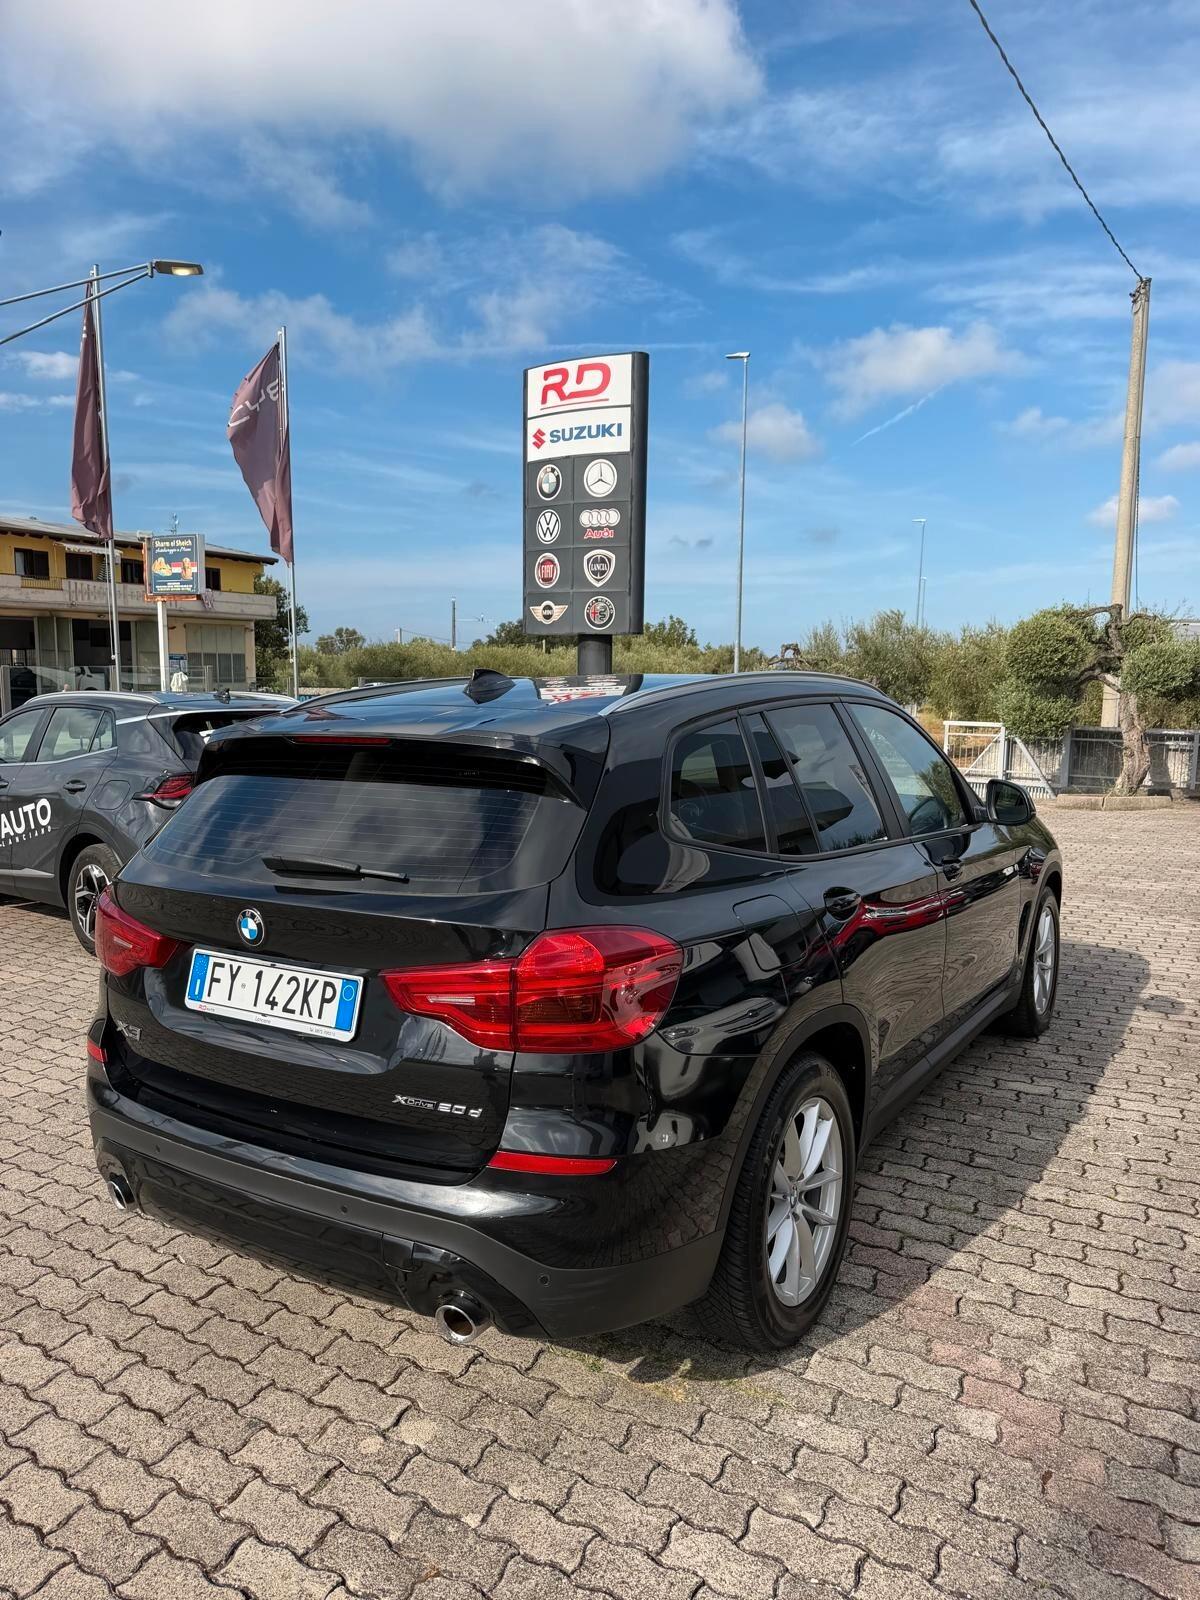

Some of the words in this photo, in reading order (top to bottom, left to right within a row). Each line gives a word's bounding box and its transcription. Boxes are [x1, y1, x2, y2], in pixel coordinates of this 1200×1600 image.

[541, 362, 611, 405] RD
[549, 422, 622, 444] SUZUKI
[584, 528, 614, 539] Audi
[541, 564, 554, 579] FIAT
[542, 608, 554, 616] MINI
[0, 798, 51, 839] AUTO
[207, 961, 241, 1001] FY
[253, 969, 337, 1020] 142KP
[116, 1020, 141, 1041] X3
